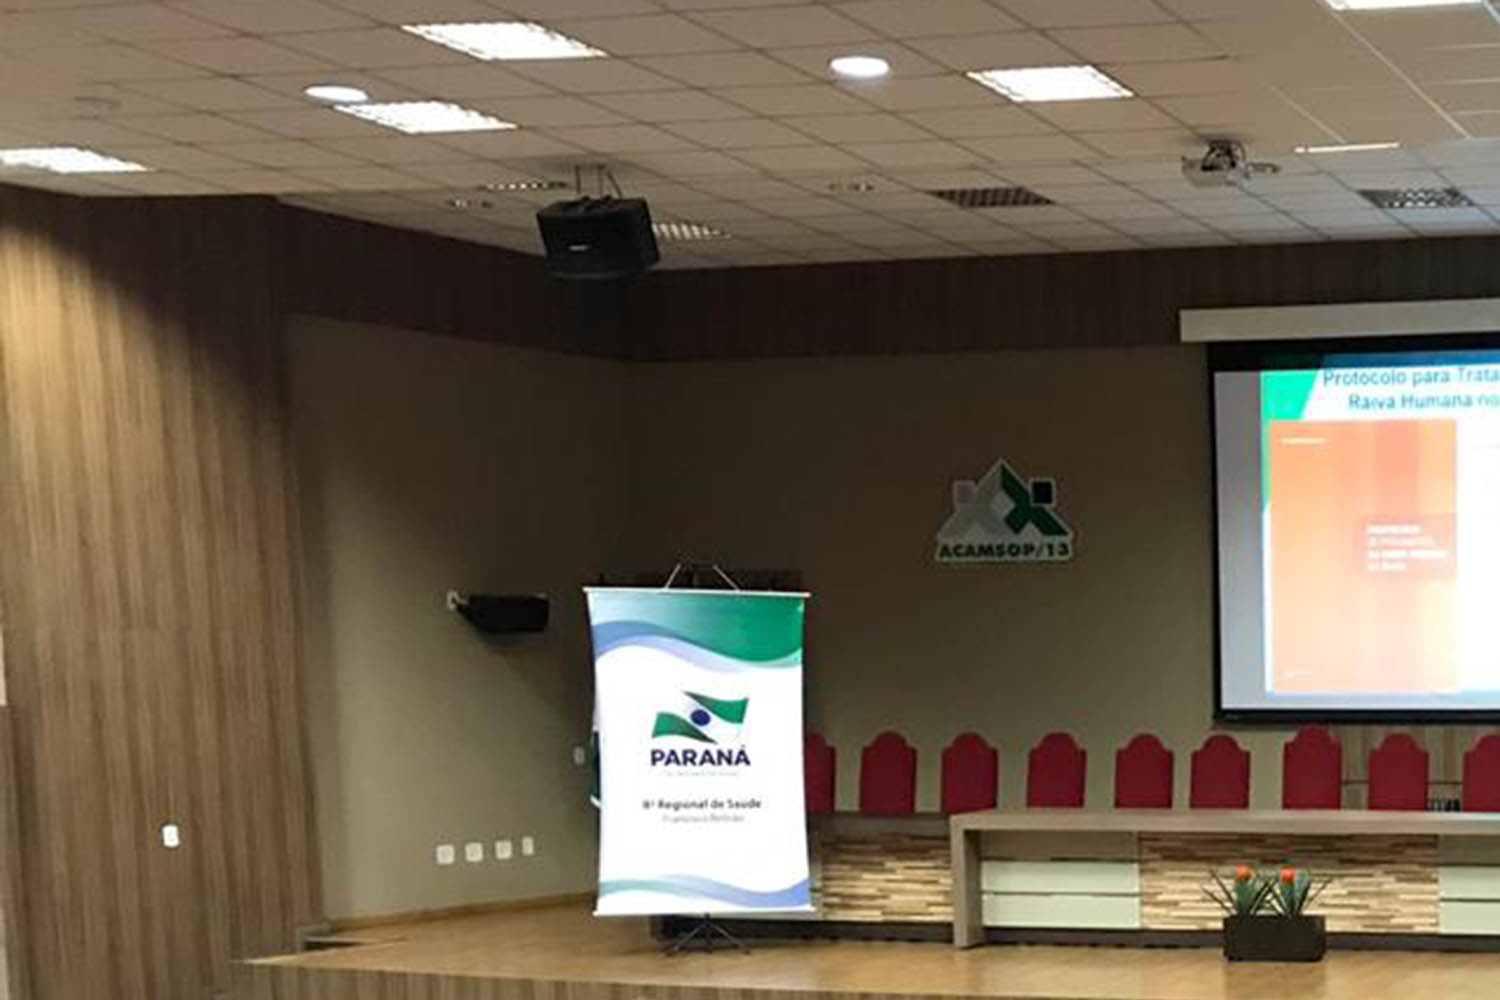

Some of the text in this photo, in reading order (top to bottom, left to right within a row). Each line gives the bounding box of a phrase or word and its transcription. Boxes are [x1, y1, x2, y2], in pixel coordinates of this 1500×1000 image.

[1412, 370, 1450, 387] para
[1401, 392, 1473, 409] Humana
[1478, 395, 1500, 407] no
[939, 543, 1070, 558] ACAMSOP/13
[650, 744, 751, 766] PARANÁ
[658, 798, 708, 812] Regional
[710, 798, 724, 809] de
